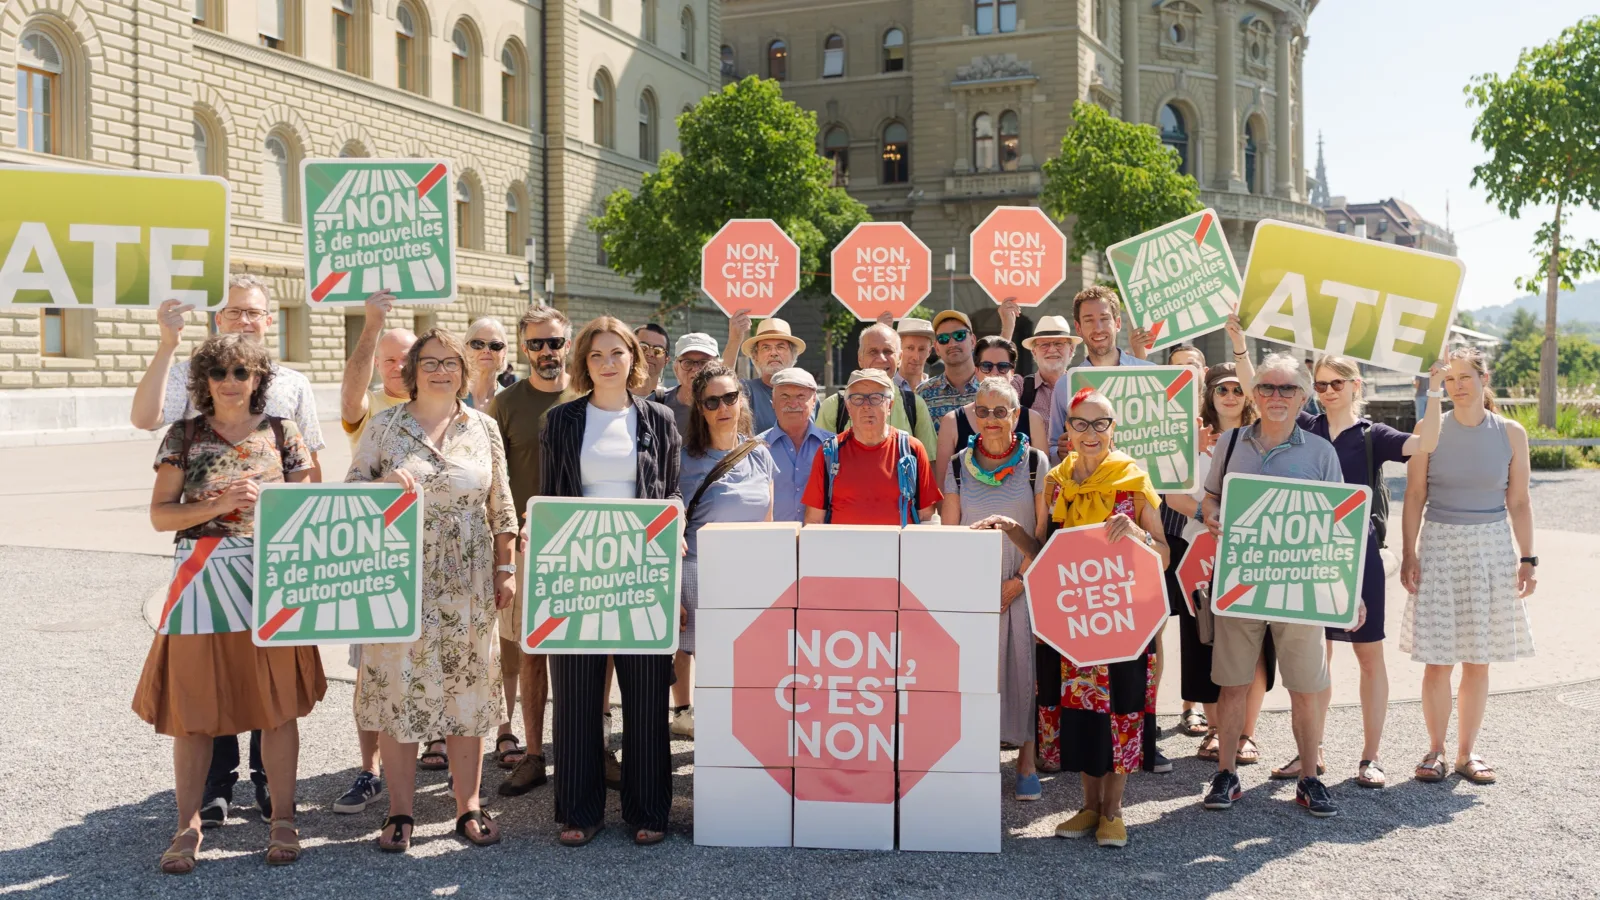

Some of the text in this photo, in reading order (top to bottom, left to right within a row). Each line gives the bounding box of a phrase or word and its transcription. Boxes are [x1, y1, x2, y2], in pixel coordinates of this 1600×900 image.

[346, 190, 416, 230] NON
[315, 220, 443, 254] à de nouvelles
[726, 243, 779, 263] NON,
[994, 230, 1046, 252] NON,
[0, 221, 209, 307] ATE
[334, 242, 432, 270] autoroutes
[856, 246, 911, 266] NON,
[1146, 241, 1201, 289] NON
[726, 281, 773, 298] NON
[857, 284, 905, 302] NON
[994, 268, 1040, 287] NON
[1134, 257, 1226, 313] à de nouvelles
[1151, 276, 1222, 321] autoroutes
[1244, 271, 1438, 373] ATE
[1114, 420, 1188, 444] nouvelles
[302, 517, 381, 562] NON
[1259, 513, 1332, 546] NON
[266, 550, 410, 587] à de nouvelles
[570, 532, 643, 573] NON
[1226, 543, 1354, 565] à de nouvelles
[535, 563, 669, 597] à de nouvelles
[1057, 554, 1135, 587] NON,
[1242, 564, 1340, 582] autoroutes
[286, 573, 396, 605] autoroutes
[553, 587, 656, 615] autoroutes
[1067, 607, 1136, 640] NON
[787, 628, 917, 676] NON,
[787, 719, 905, 762] NON
